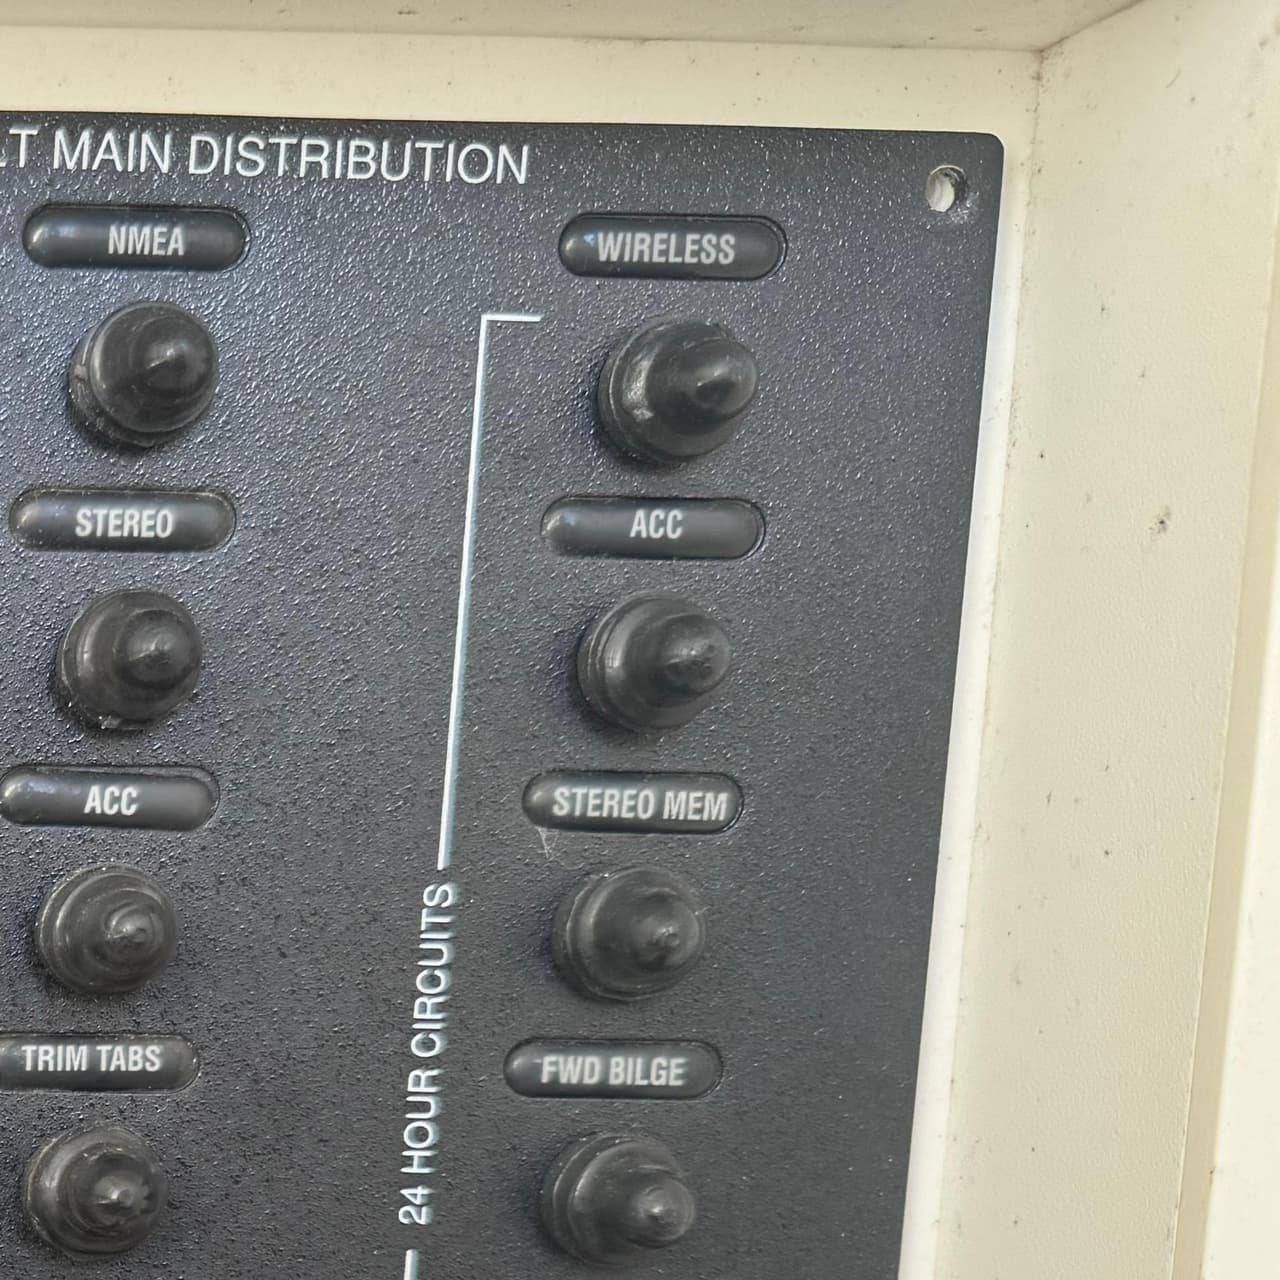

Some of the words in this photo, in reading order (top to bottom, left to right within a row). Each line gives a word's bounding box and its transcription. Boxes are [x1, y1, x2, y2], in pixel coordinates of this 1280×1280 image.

[51, 129, 171, 175] MAIN
[188, 133, 530, 187] DISTRIBUTION
[107, 225, 185, 258] NMEA
[596, 232, 737, 266] WIRELESS
[74, 507, 175, 540] STEREO
[629, 510, 684, 541] ACC
[83, 784, 140, 817] ACC
[551, 787, 655, 821] STEREO
[663, 790, 729, 823] MEM
[410, 882, 458, 1058] CIRCUITS
[20, 1044, 89, 1073] TRIM
[98, 1044, 162, 1073] TABS
[539, 1054, 605, 1085] FWD
[607, 1056, 688, 1087] BILGE
[400, 1067, 443, 1174] HOUR
[398, 1184, 435, 1226] 24
